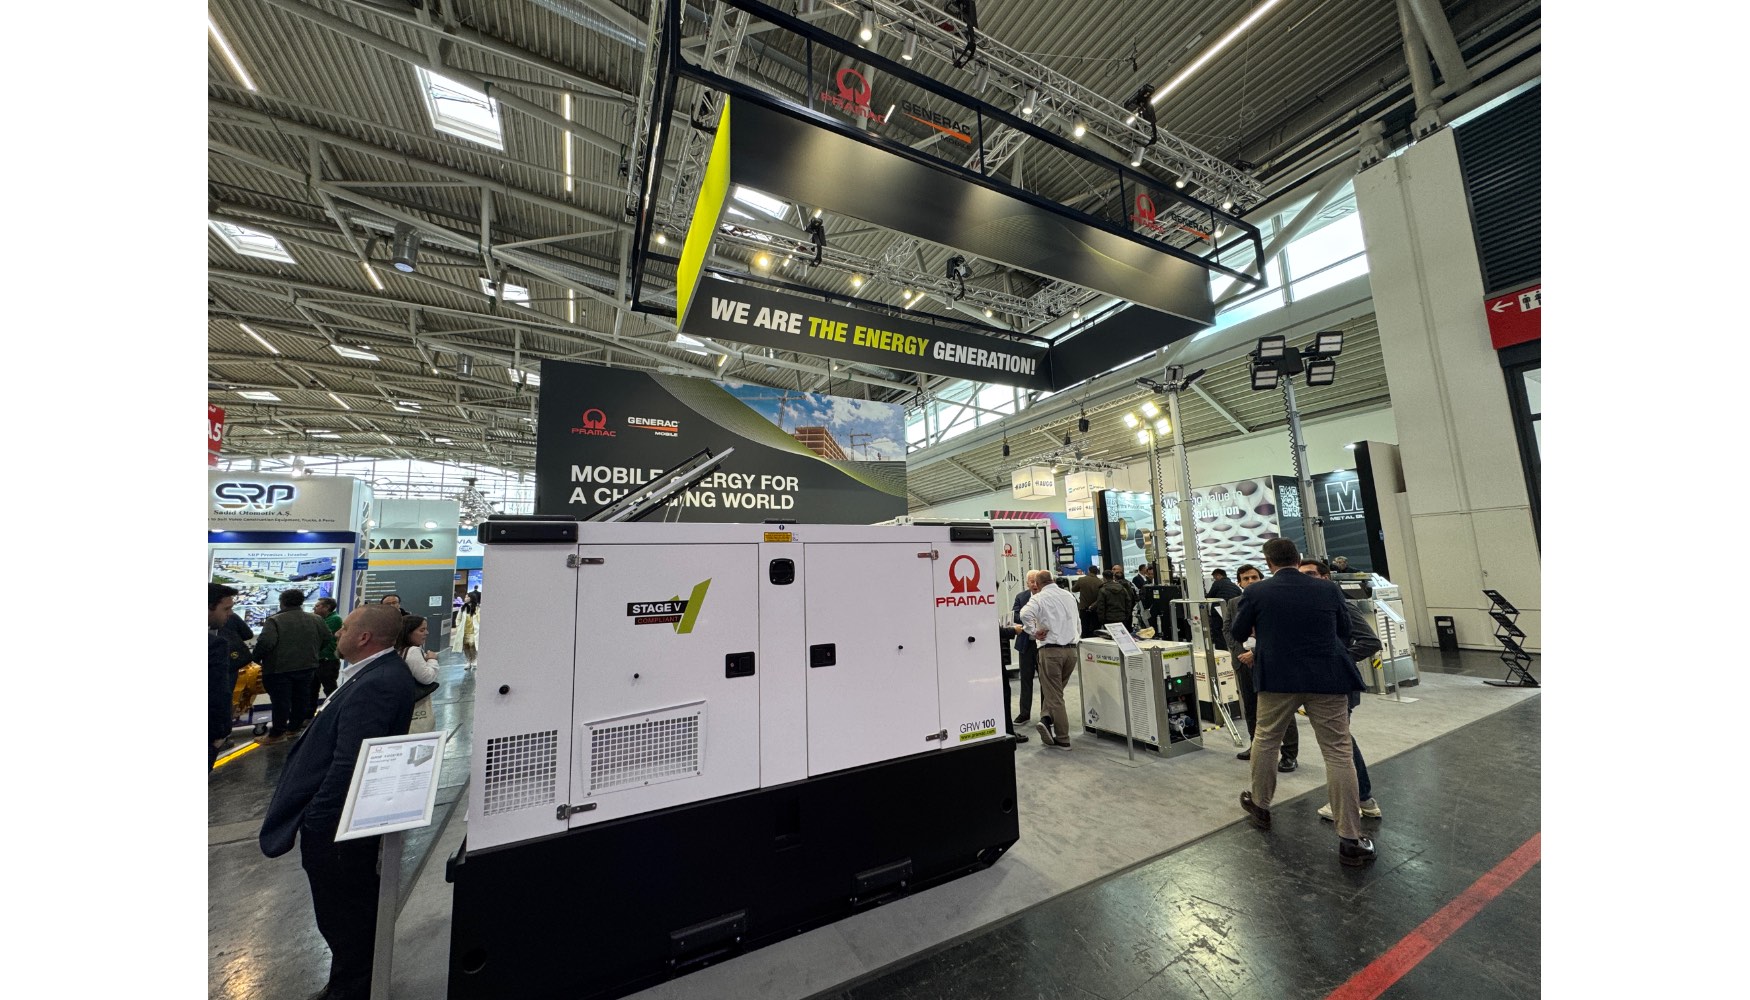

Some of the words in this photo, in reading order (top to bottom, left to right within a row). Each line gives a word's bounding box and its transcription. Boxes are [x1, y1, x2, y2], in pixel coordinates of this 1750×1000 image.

[820, 91, 887, 125] PRAMAC
[901, 101, 971, 135] GENERAC
[711, 297, 751, 325] WE
[753, 306, 803, 335] ARE
[808, 316, 849, 343] THE
[852, 325, 930, 357] ENERGY
[932, 341, 1037, 376] GENERATION!
[571, 428, 617, 437] PRAMAC
[627, 416, 679, 428] GENERAC
[215, 482, 295, 504] SRP
[760, 475, 799, 492] FOR
[568, 487, 587, 505] A
[721, 492, 795, 510] WORLD
[632, 603, 672, 614] STAGE
[673, 602, 682, 612] V
[936, 594, 995, 607] PRAMAC
[637, 616, 679, 624] COMPLIANT
[960, 721, 981, 734] GRW
[981, 718, 996, 729] 100
